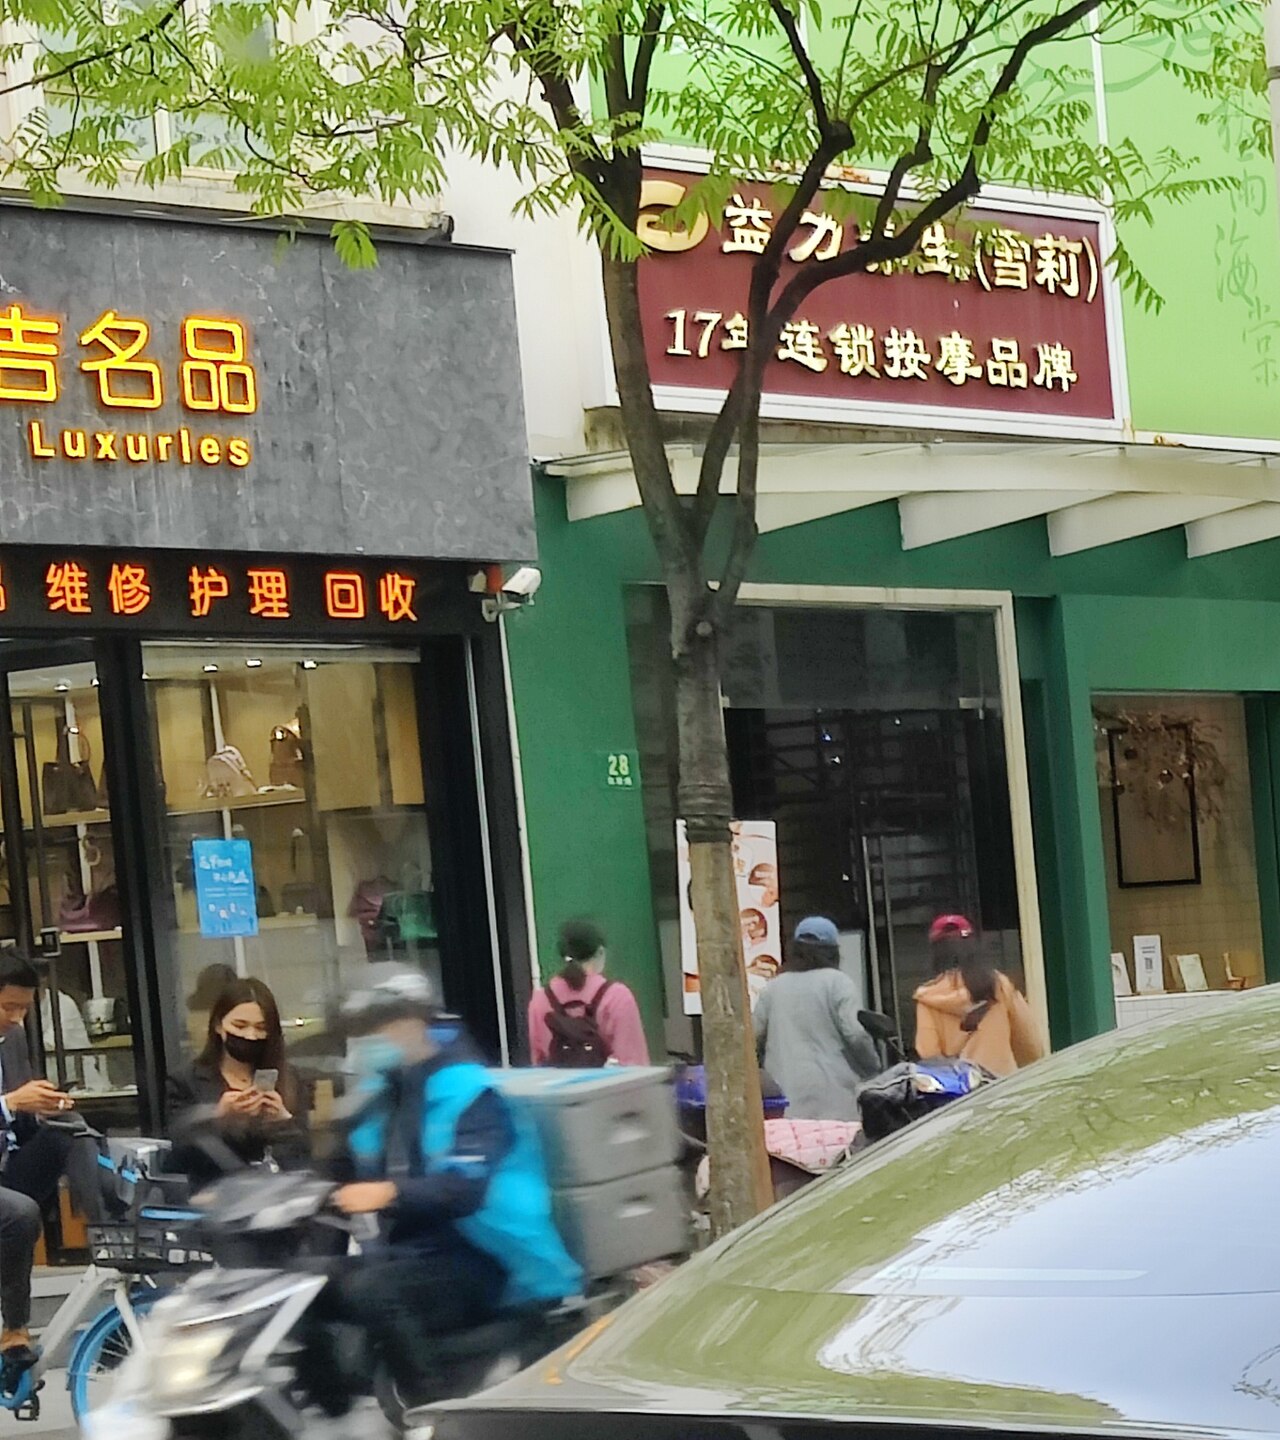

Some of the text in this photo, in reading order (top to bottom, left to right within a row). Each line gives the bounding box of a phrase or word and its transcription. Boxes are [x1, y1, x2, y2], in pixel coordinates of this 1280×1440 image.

[28, 422, 251, 468] Luxuries
[45, 562, 151, 615] 维修
[189, 567, 290, 619] 护理
[324, 573, 418, 622] 回收
[608, 754, 630, 776] 28
